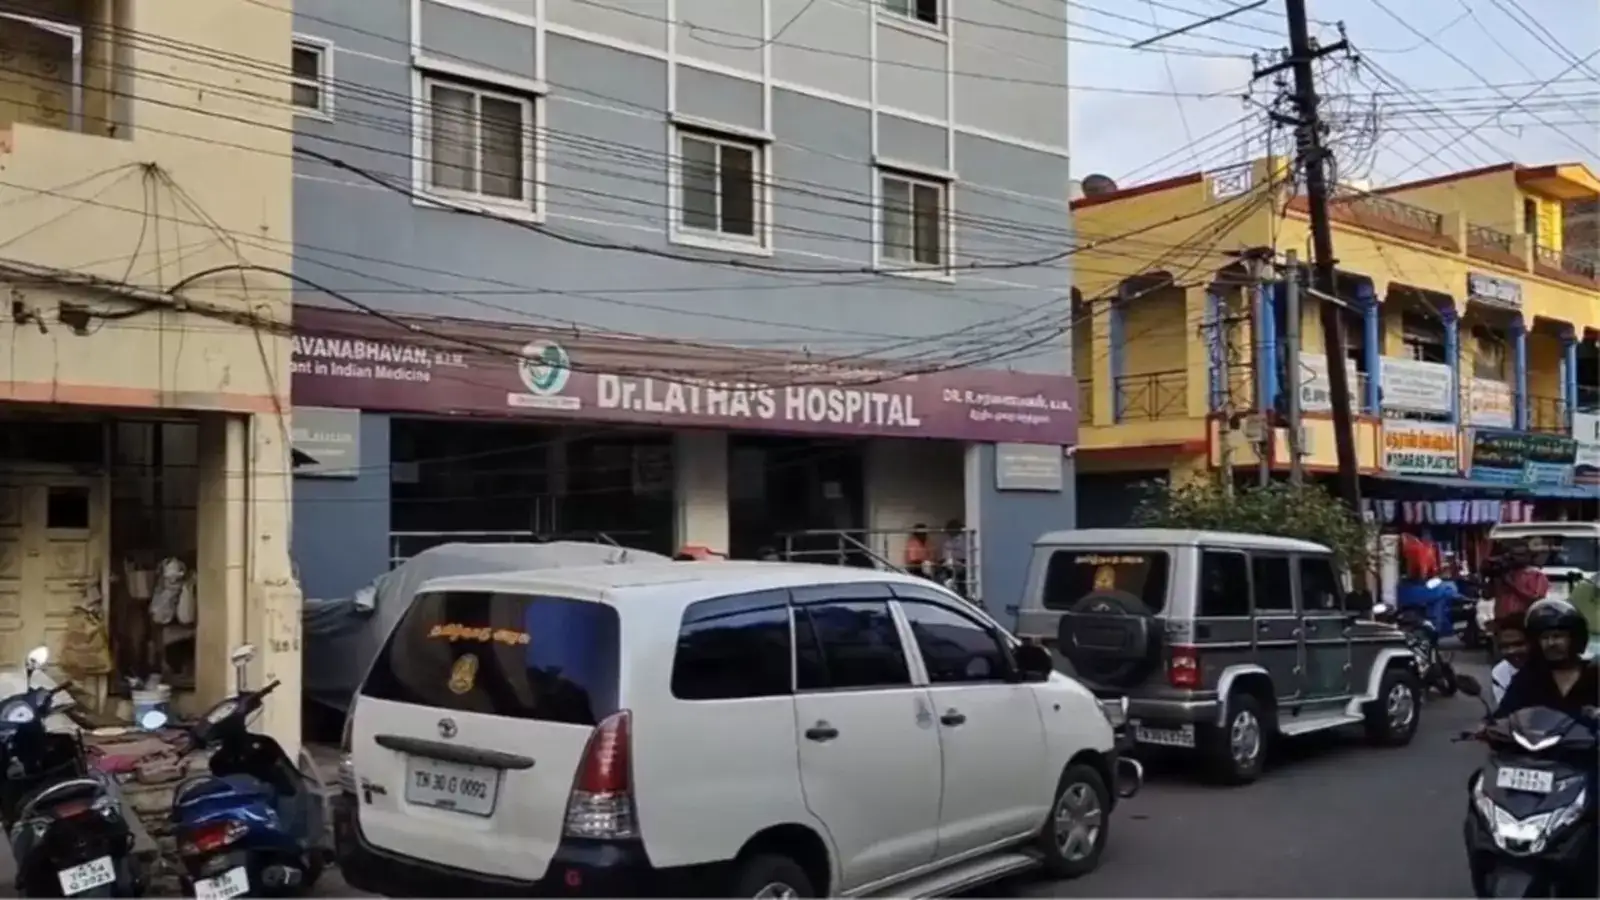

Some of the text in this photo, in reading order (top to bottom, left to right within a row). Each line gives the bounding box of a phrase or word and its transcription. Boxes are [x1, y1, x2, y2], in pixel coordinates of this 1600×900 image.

[314, 360, 328, 375] in
[331, 361, 372, 378] Indian
[375, 365, 431, 382] Medicine
[597, 373, 921, 427] Dr.LATHA'S HOSPITAL
